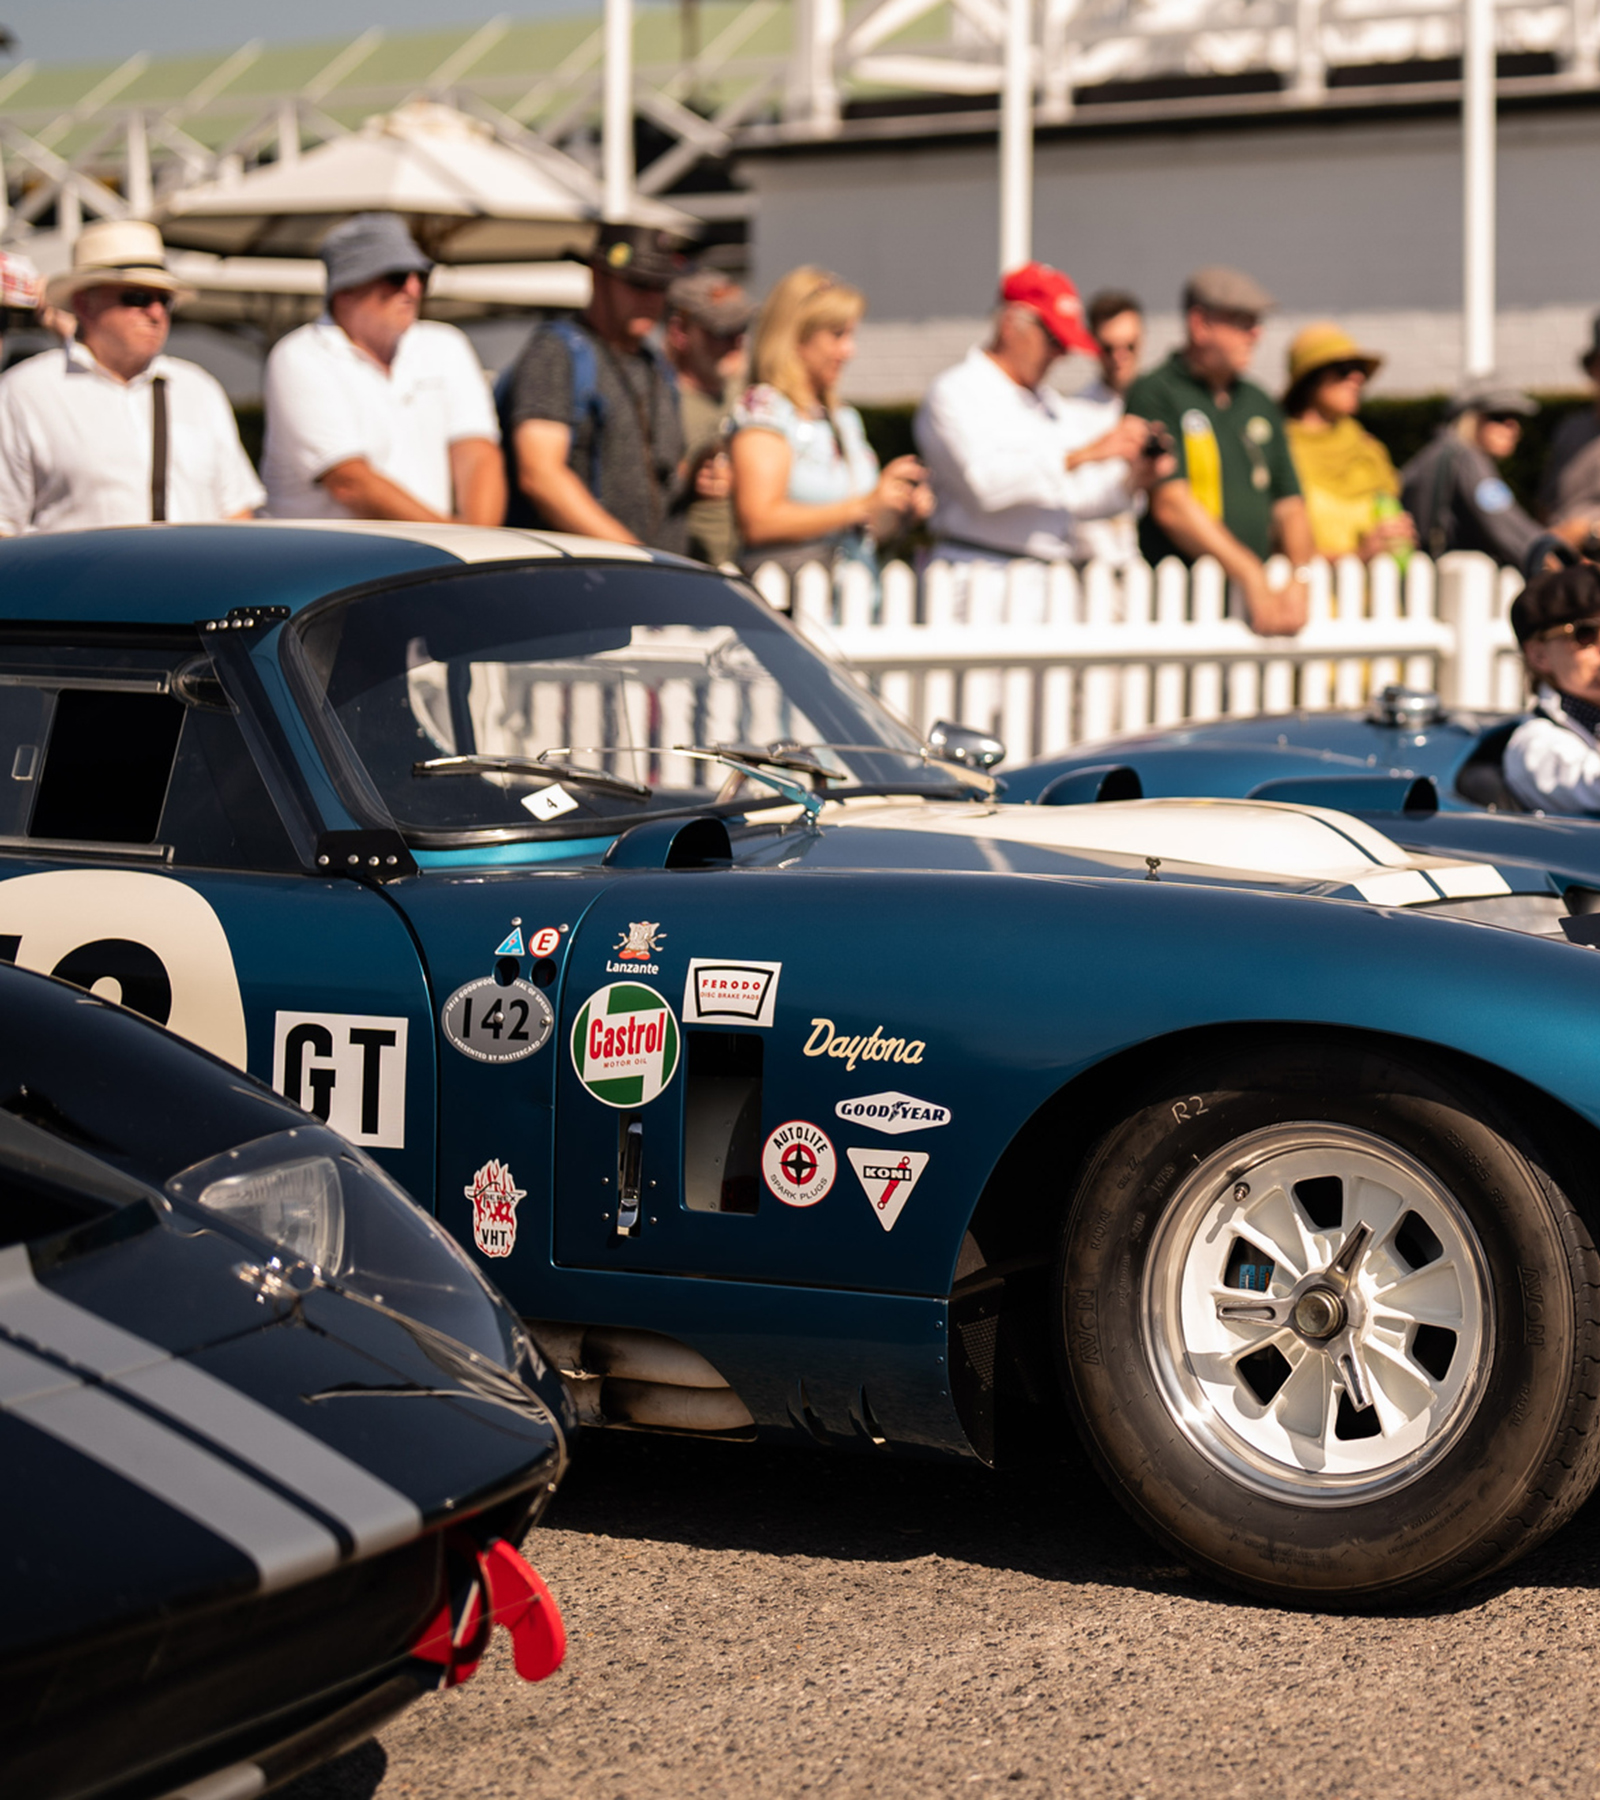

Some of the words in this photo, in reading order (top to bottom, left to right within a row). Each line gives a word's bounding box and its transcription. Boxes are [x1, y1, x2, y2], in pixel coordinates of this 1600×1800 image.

[537, 933, 553, 951] E
[606, 960, 659, 975] Lanzante
[458, 977, 496, 998] GOODWOO
[702, 979, 761, 991] FERODO
[463, 997, 530, 1041] 142
[589, 1011, 666, 1060] Castrol
[803, 1018, 926, 1072] Daytona
[453, 1037, 487, 1060] PRESENTED
[488, 1054, 498, 1062] BY
[498, 1040, 541, 1061] MASTERCARD
[603, 1059, 631, 1068] MOTOR
[634, 1058, 648, 1066] OIL
[283, 1023, 396, 1135] GT
[841, 1101, 946, 1122] GOODYEAR
[1171, 1096, 1209, 1124] R2
[772, 1126, 828, 1155] AUTOLITE
[770, 1173, 797, 1200] SPARK
[800, 1177, 828, 1200] PLUGS
[865, 1167, 911, 1179] KONI
[482, 1228, 507, 1246] VHT
[1091, 1208, 1111, 1250] RADIAL
[1521, 1267, 1546, 1346] AVON
[1076, 1289, 1100, 1366] AVON
